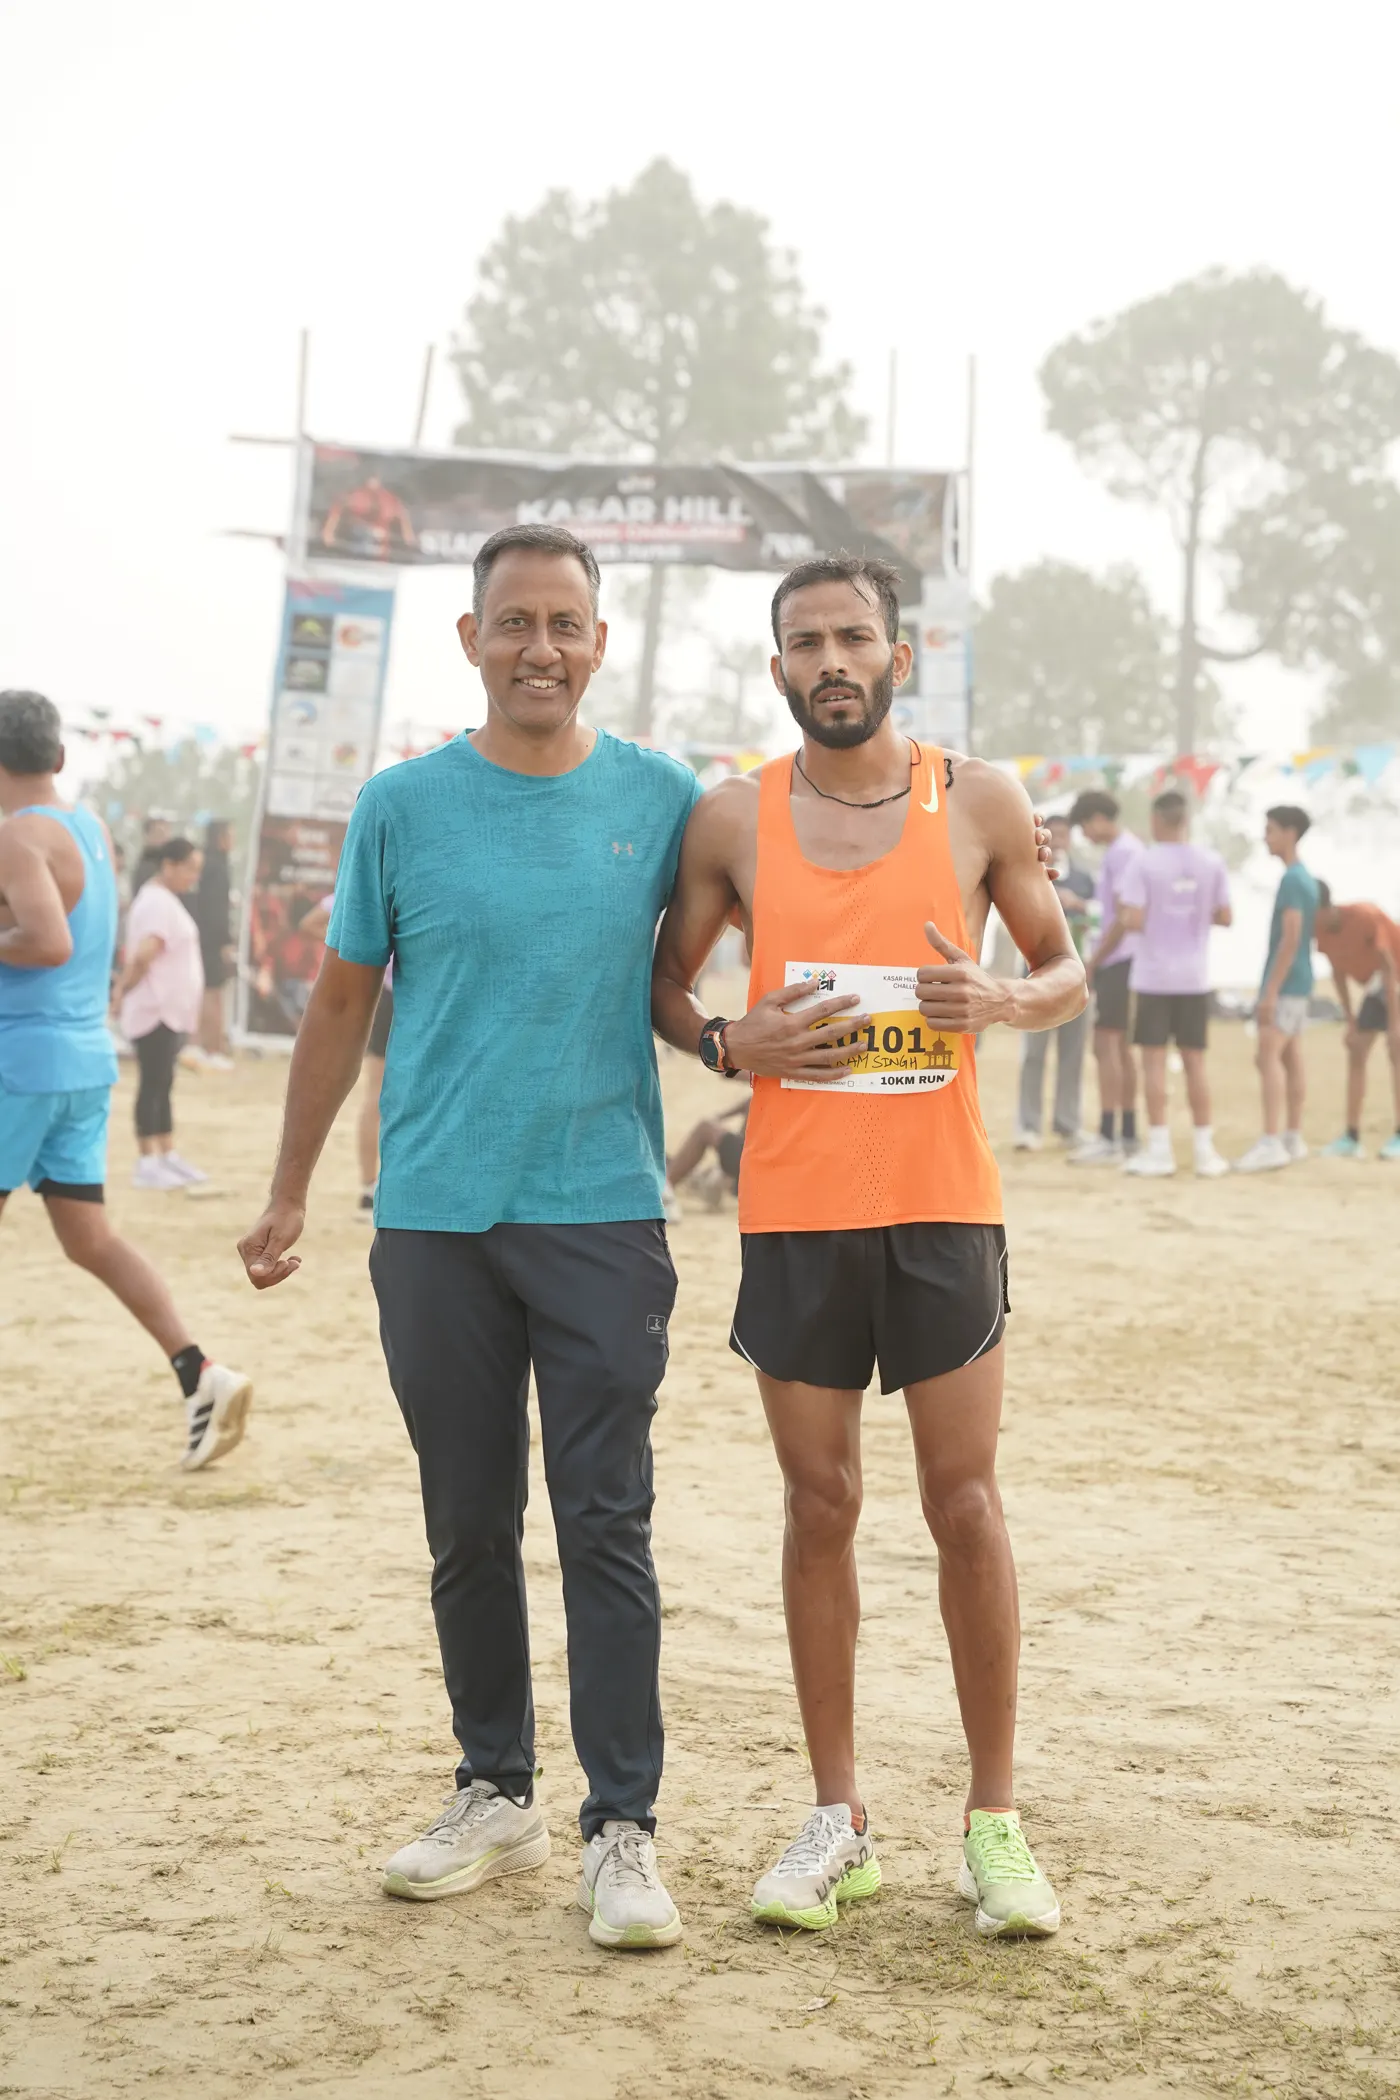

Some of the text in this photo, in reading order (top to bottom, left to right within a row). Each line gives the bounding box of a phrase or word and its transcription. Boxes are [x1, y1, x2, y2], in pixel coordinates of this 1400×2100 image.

[516, 495, 753, 525] KASAR HILL
[871, 1054, 918, 1070] SINGH
[880, 1074, 945, 1086] 10KM RUN
